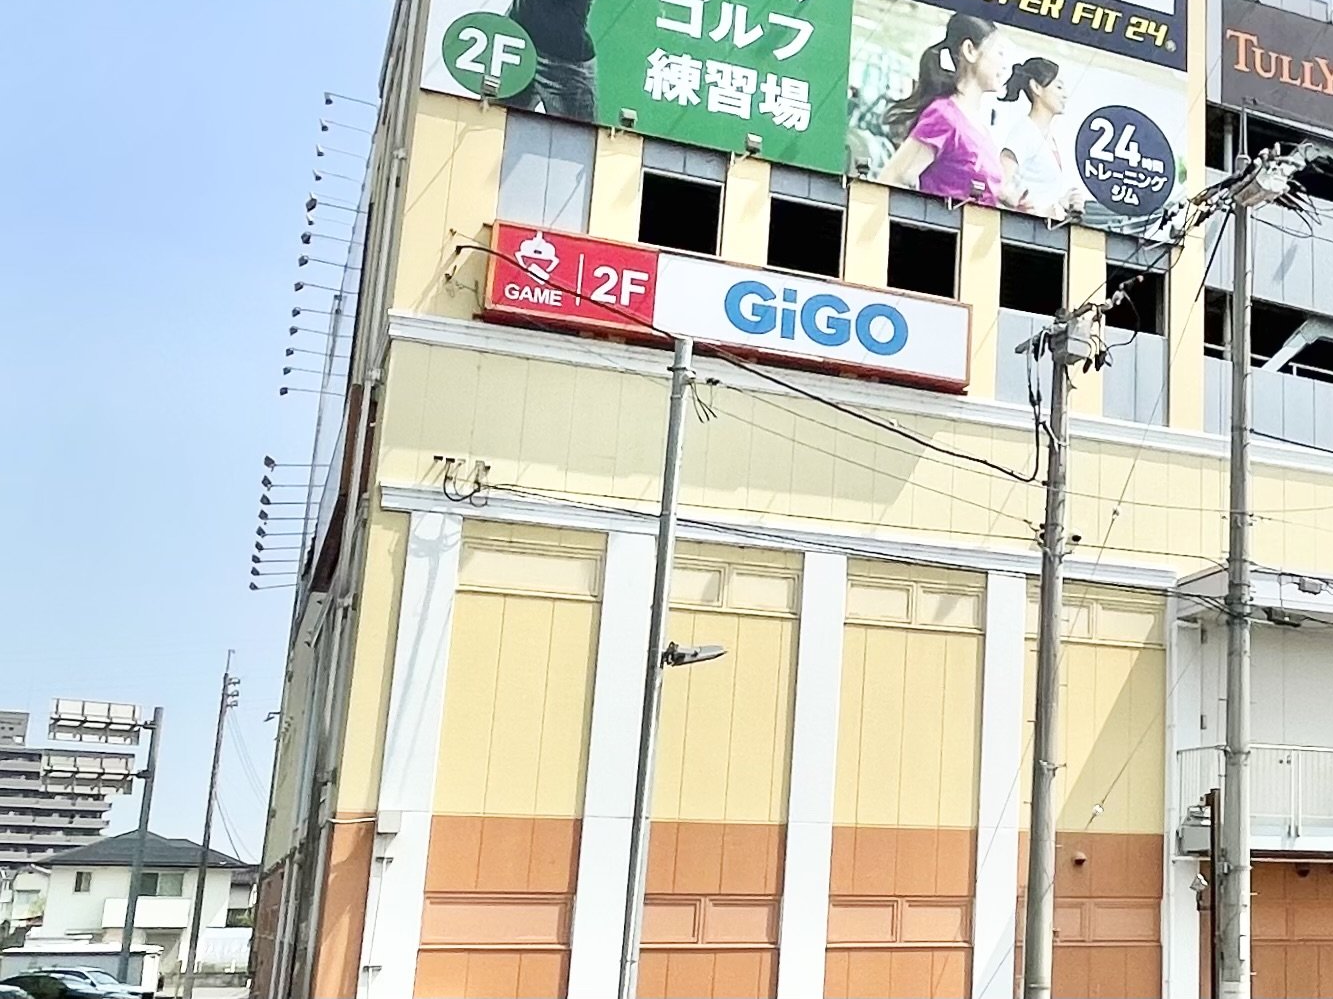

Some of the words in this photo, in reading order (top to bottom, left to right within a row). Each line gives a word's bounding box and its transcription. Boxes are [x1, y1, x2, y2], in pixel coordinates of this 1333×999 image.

[1071, 1, 1123, 34] FIT
[1125, 15, 1169, 48] 24
[455, 26, 526, 78] 2F
[643, 47, 812, 132] 練習場
[1084, 159, 1168, 192] トレーニング
[1110, 184, 1140, 206] ジム
[504, 282, 563, 308] GAME
[590, 264, 650, 308] 2F
[724, 279, 910, 357] GiGO
